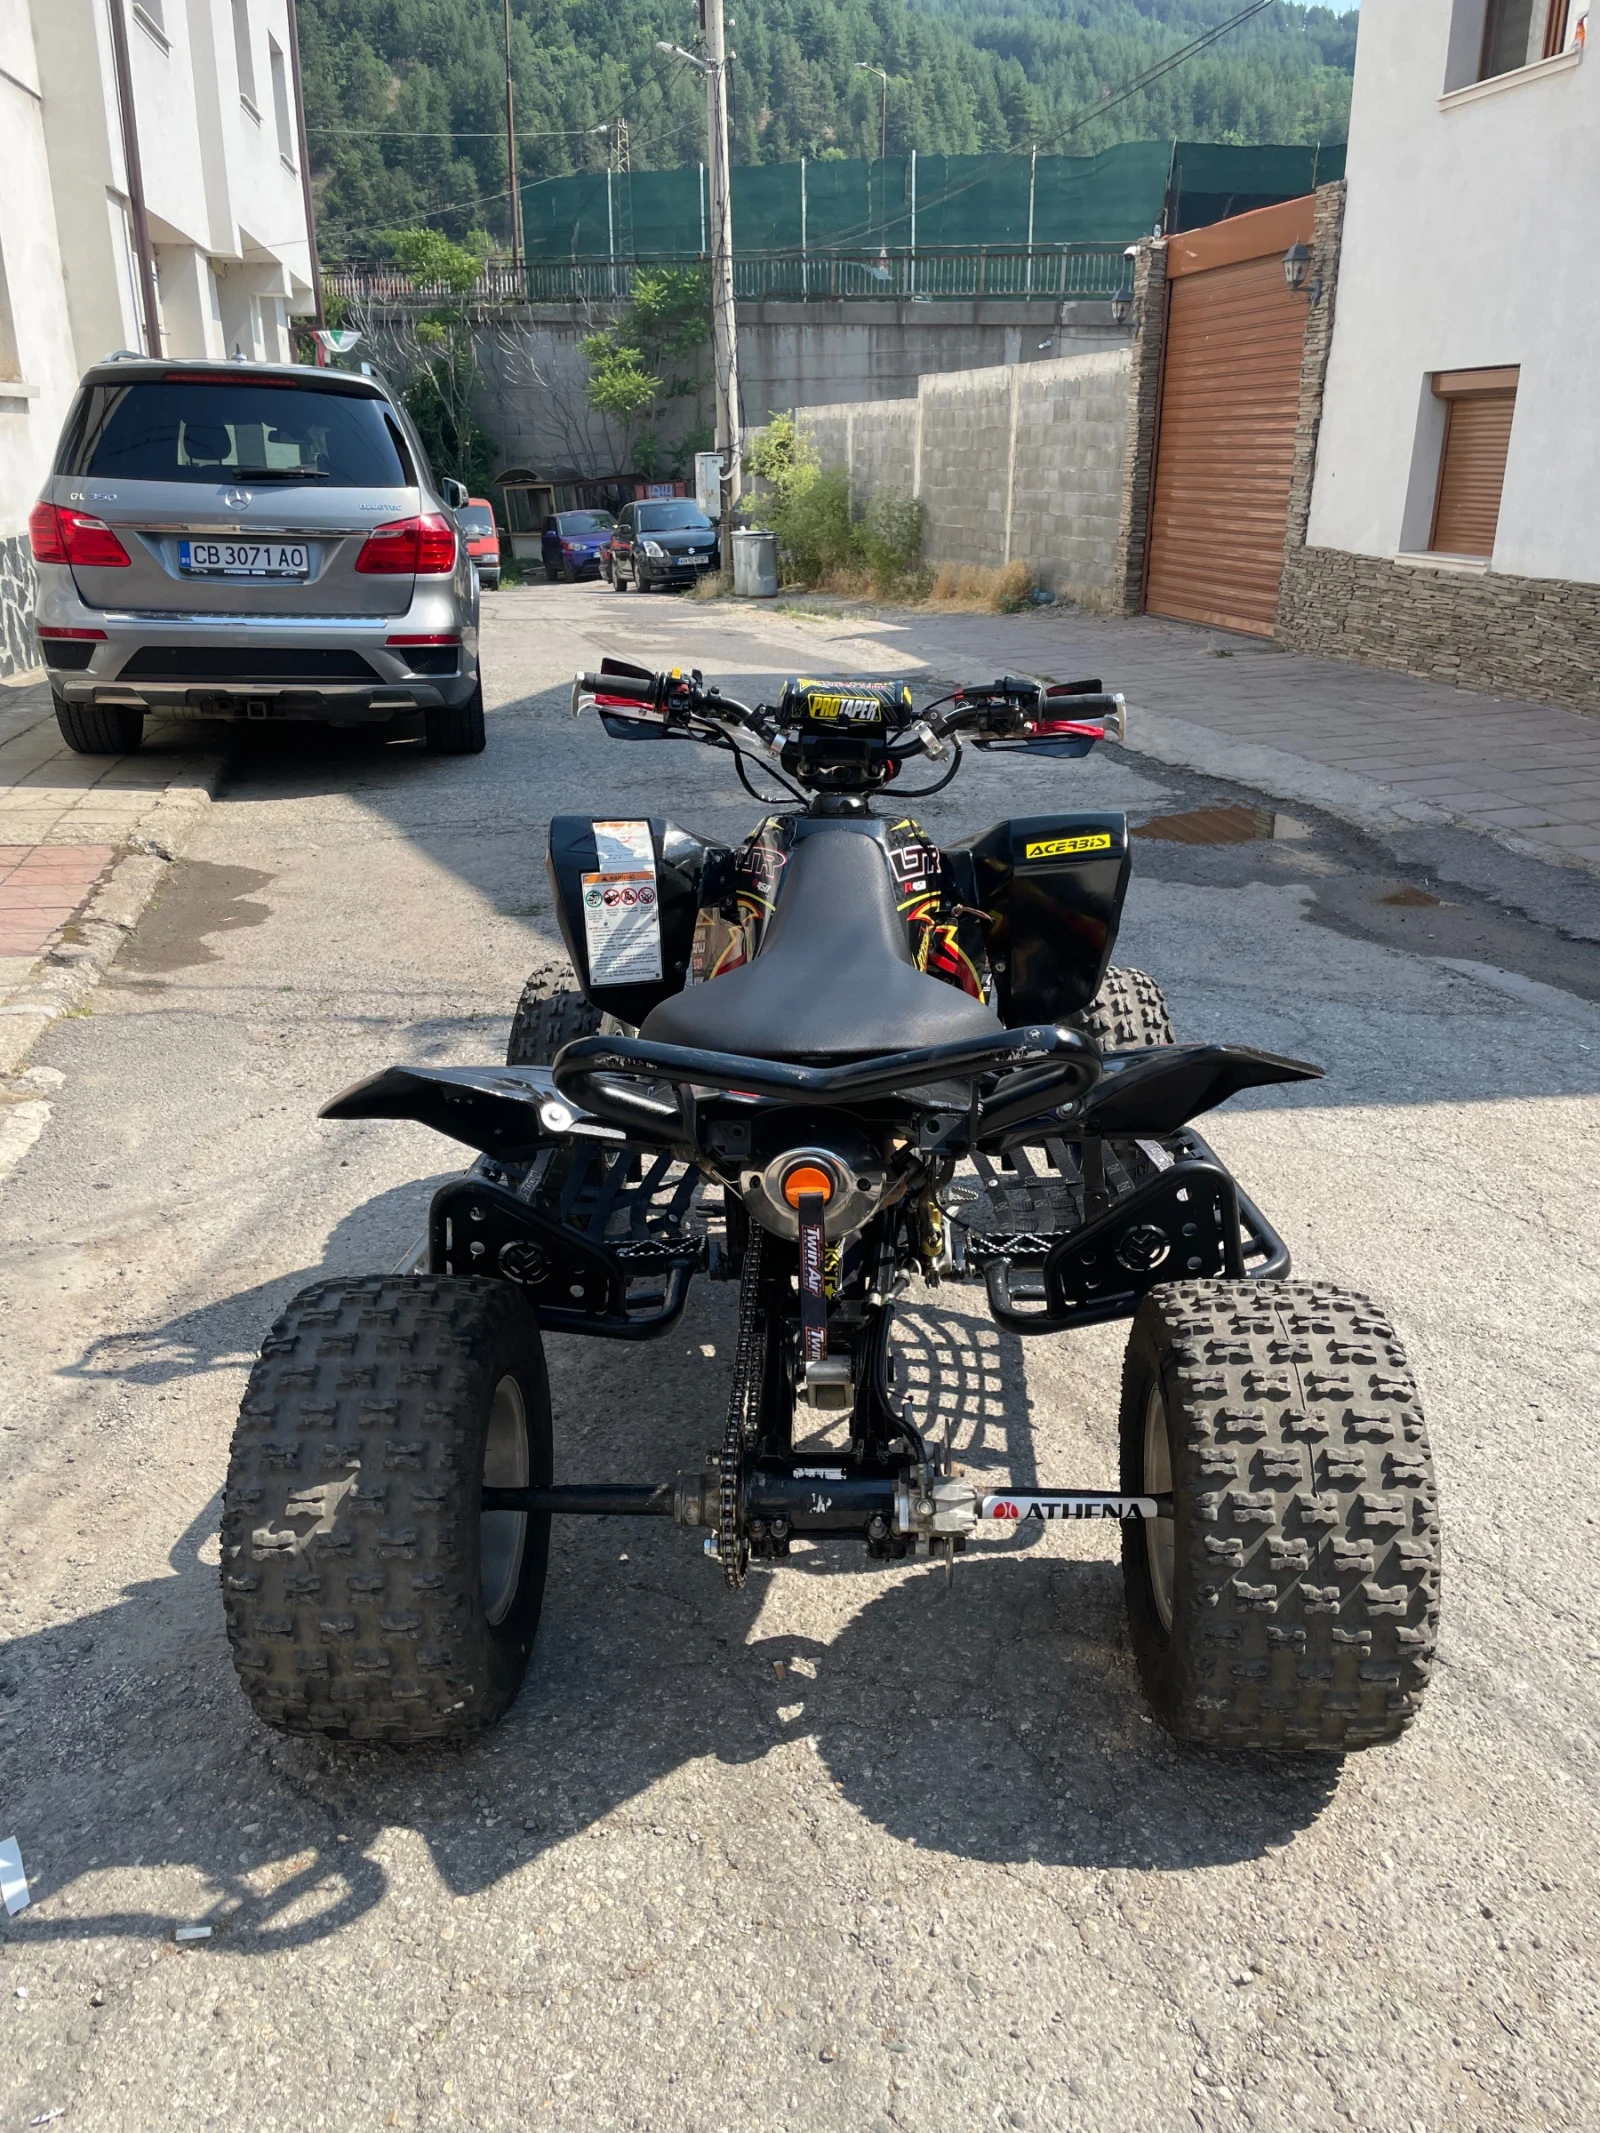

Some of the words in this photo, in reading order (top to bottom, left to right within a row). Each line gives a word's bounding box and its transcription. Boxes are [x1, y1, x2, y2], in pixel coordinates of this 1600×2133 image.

[193, 545, 220, 565] CB
[225, 546, 272, 567] 3071
[278, 548, 303, 567] AO
[812, 696, 877, 720] PROTAPER
[1029, 837, 1107, 856] ACERBIS
[806, 1227, 821, 1266] Twin
[808, 1266, 822, 1295] Air
[1026, 1503, 1138, 1519] ATHENA
